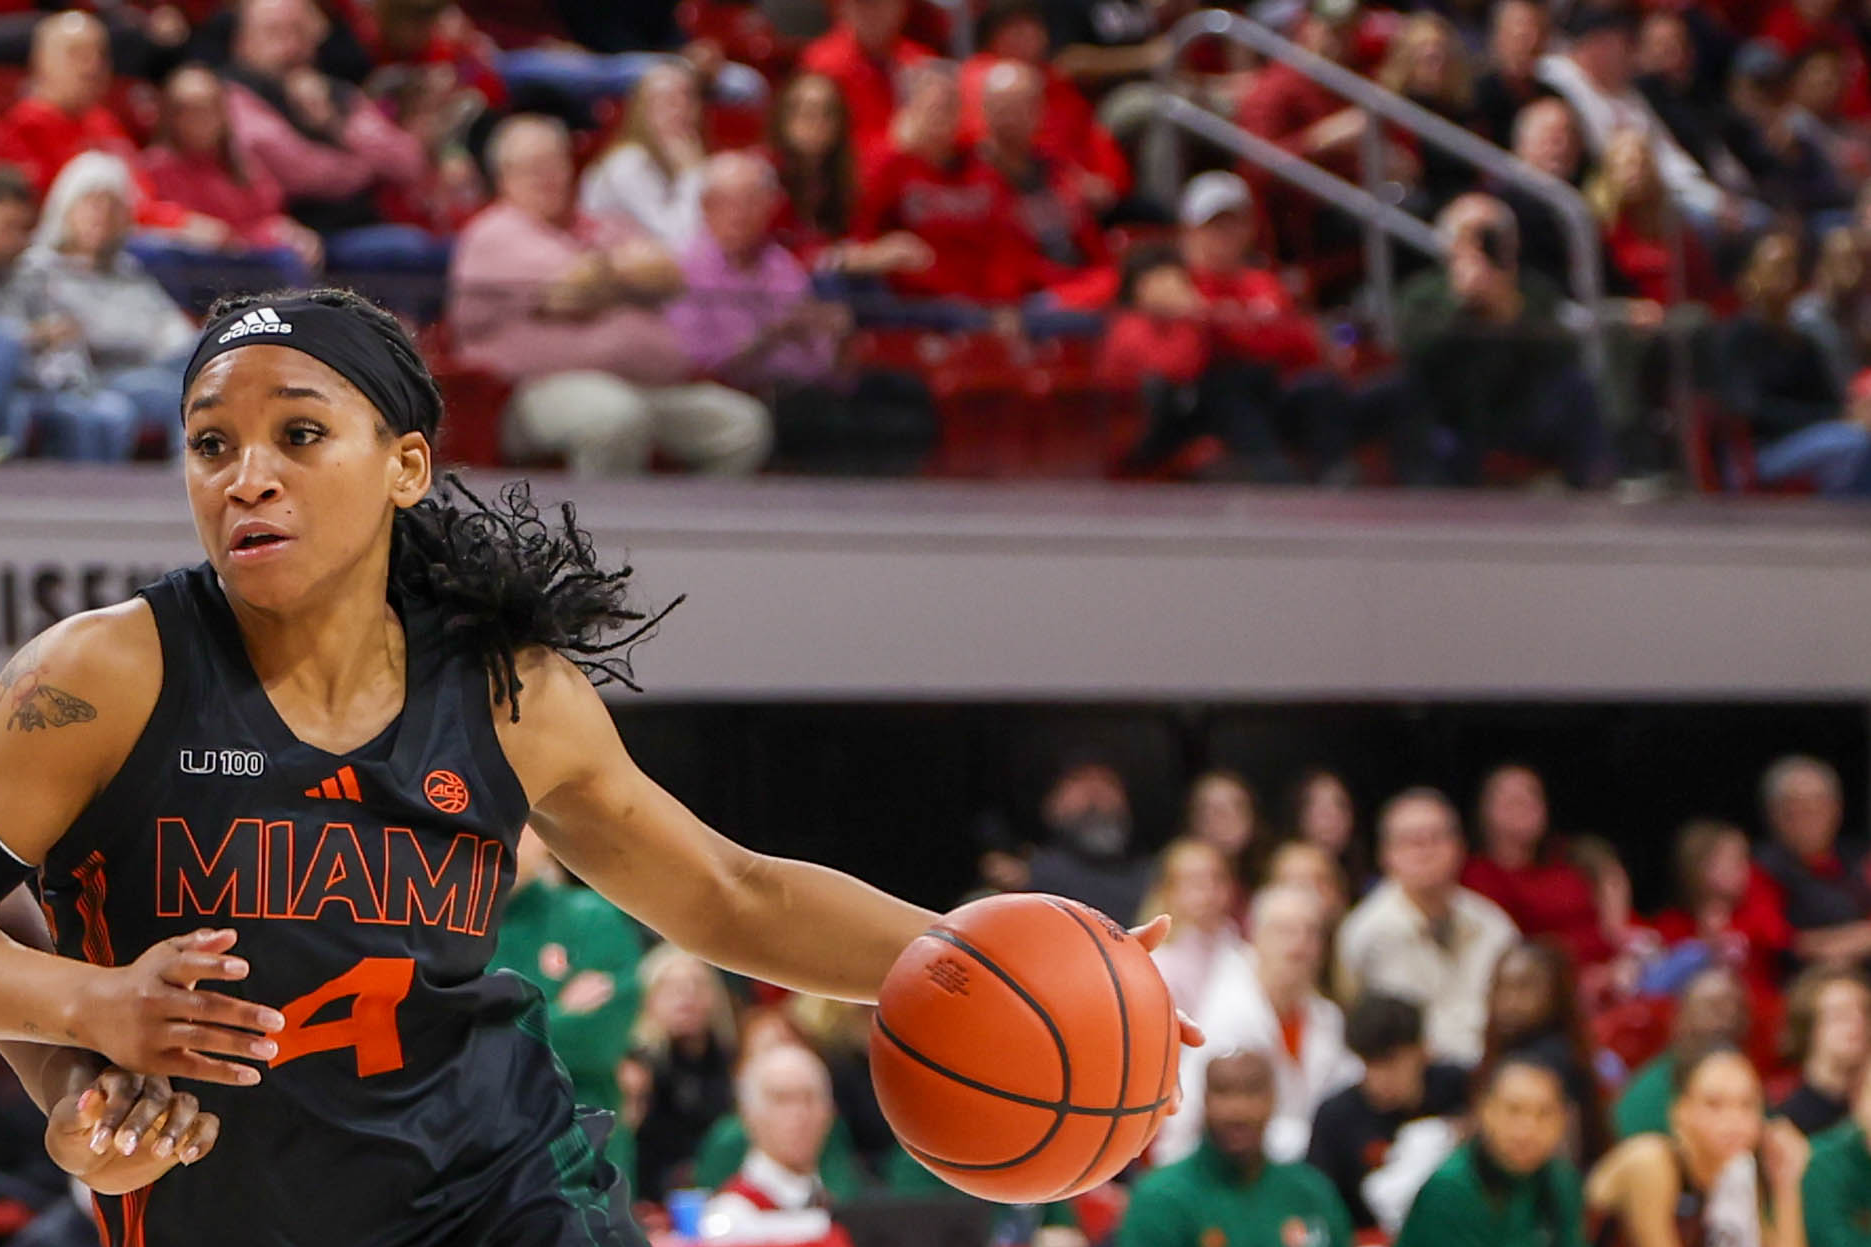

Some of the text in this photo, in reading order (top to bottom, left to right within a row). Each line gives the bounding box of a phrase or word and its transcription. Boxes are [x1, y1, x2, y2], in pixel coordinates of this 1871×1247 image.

[218, 322, 293, 345] adidas
[219, 750, 264, 776] 100
[156, 817, 503, 936] MIAMI
[266, 957, 416, 1078] 4
